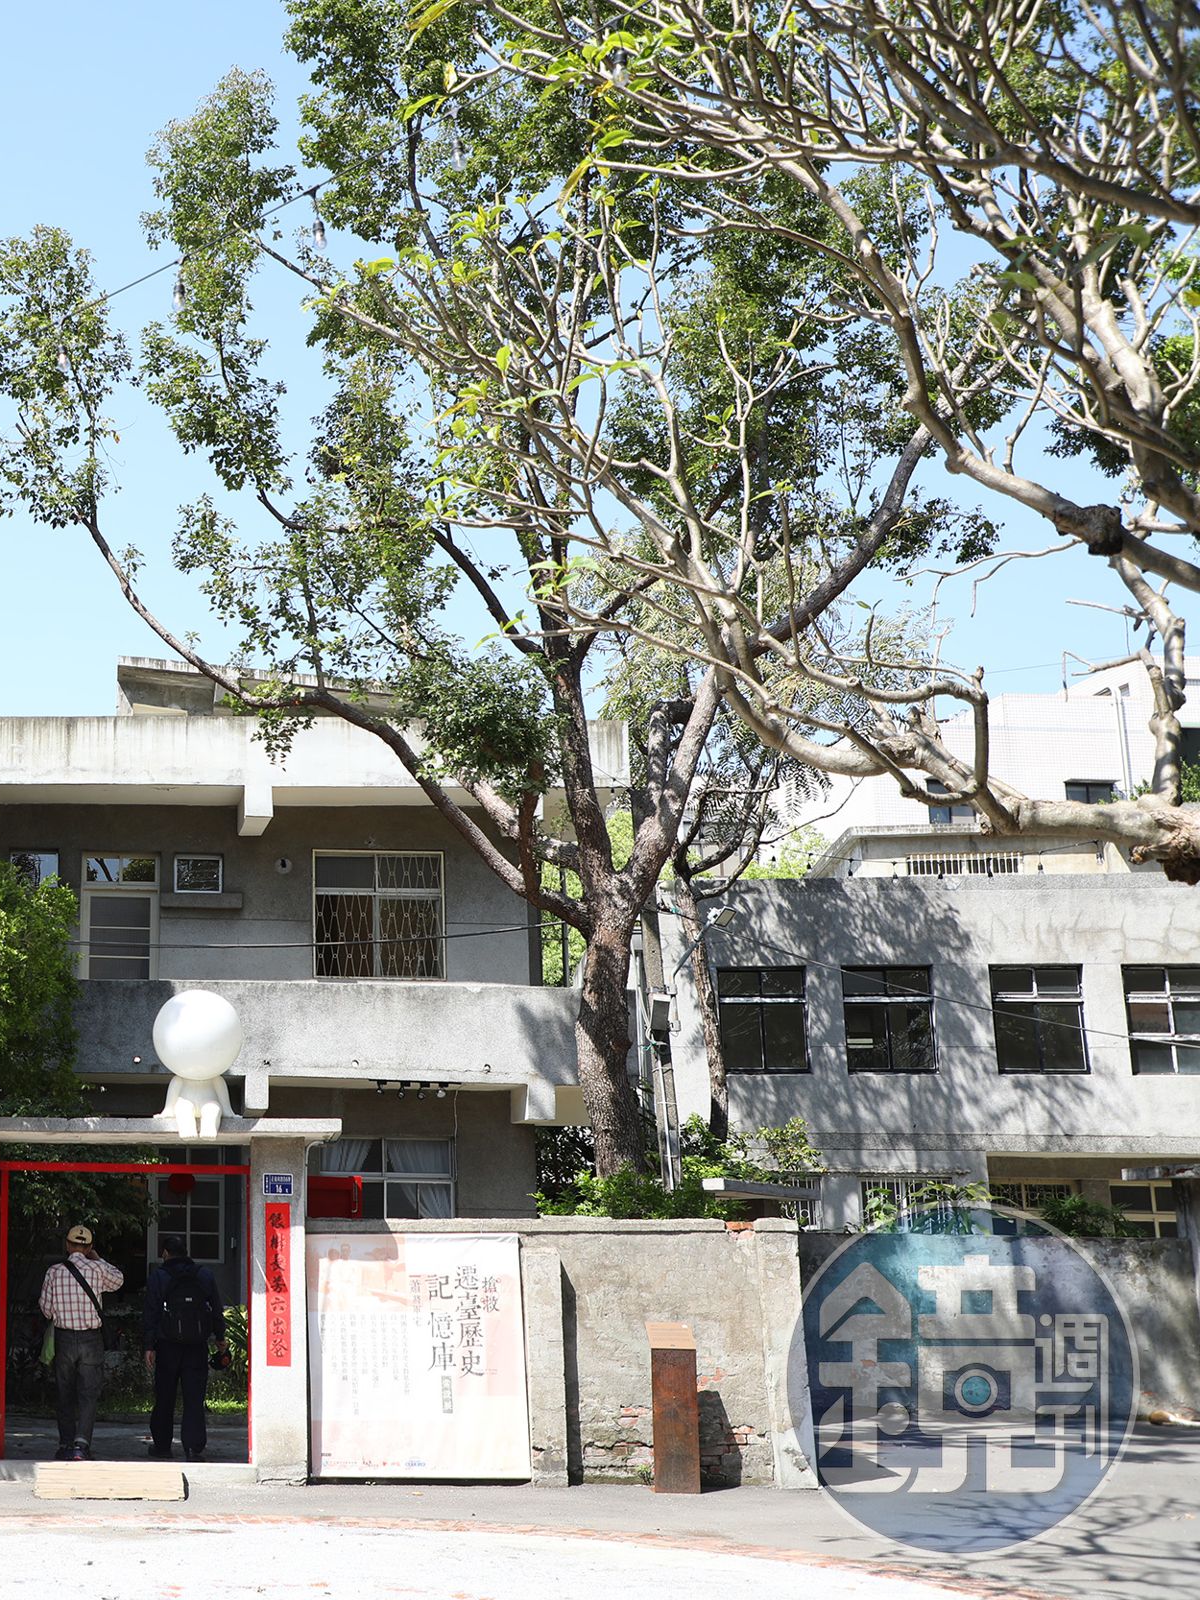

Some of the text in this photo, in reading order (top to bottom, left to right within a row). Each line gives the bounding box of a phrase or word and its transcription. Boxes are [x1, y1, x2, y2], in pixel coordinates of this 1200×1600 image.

[424, 1274, 457, 1372] 記憶庫
[454, 1264, 485, 1378] 遷臺歷史
[482, 1275, 500, 1313] 搶救
